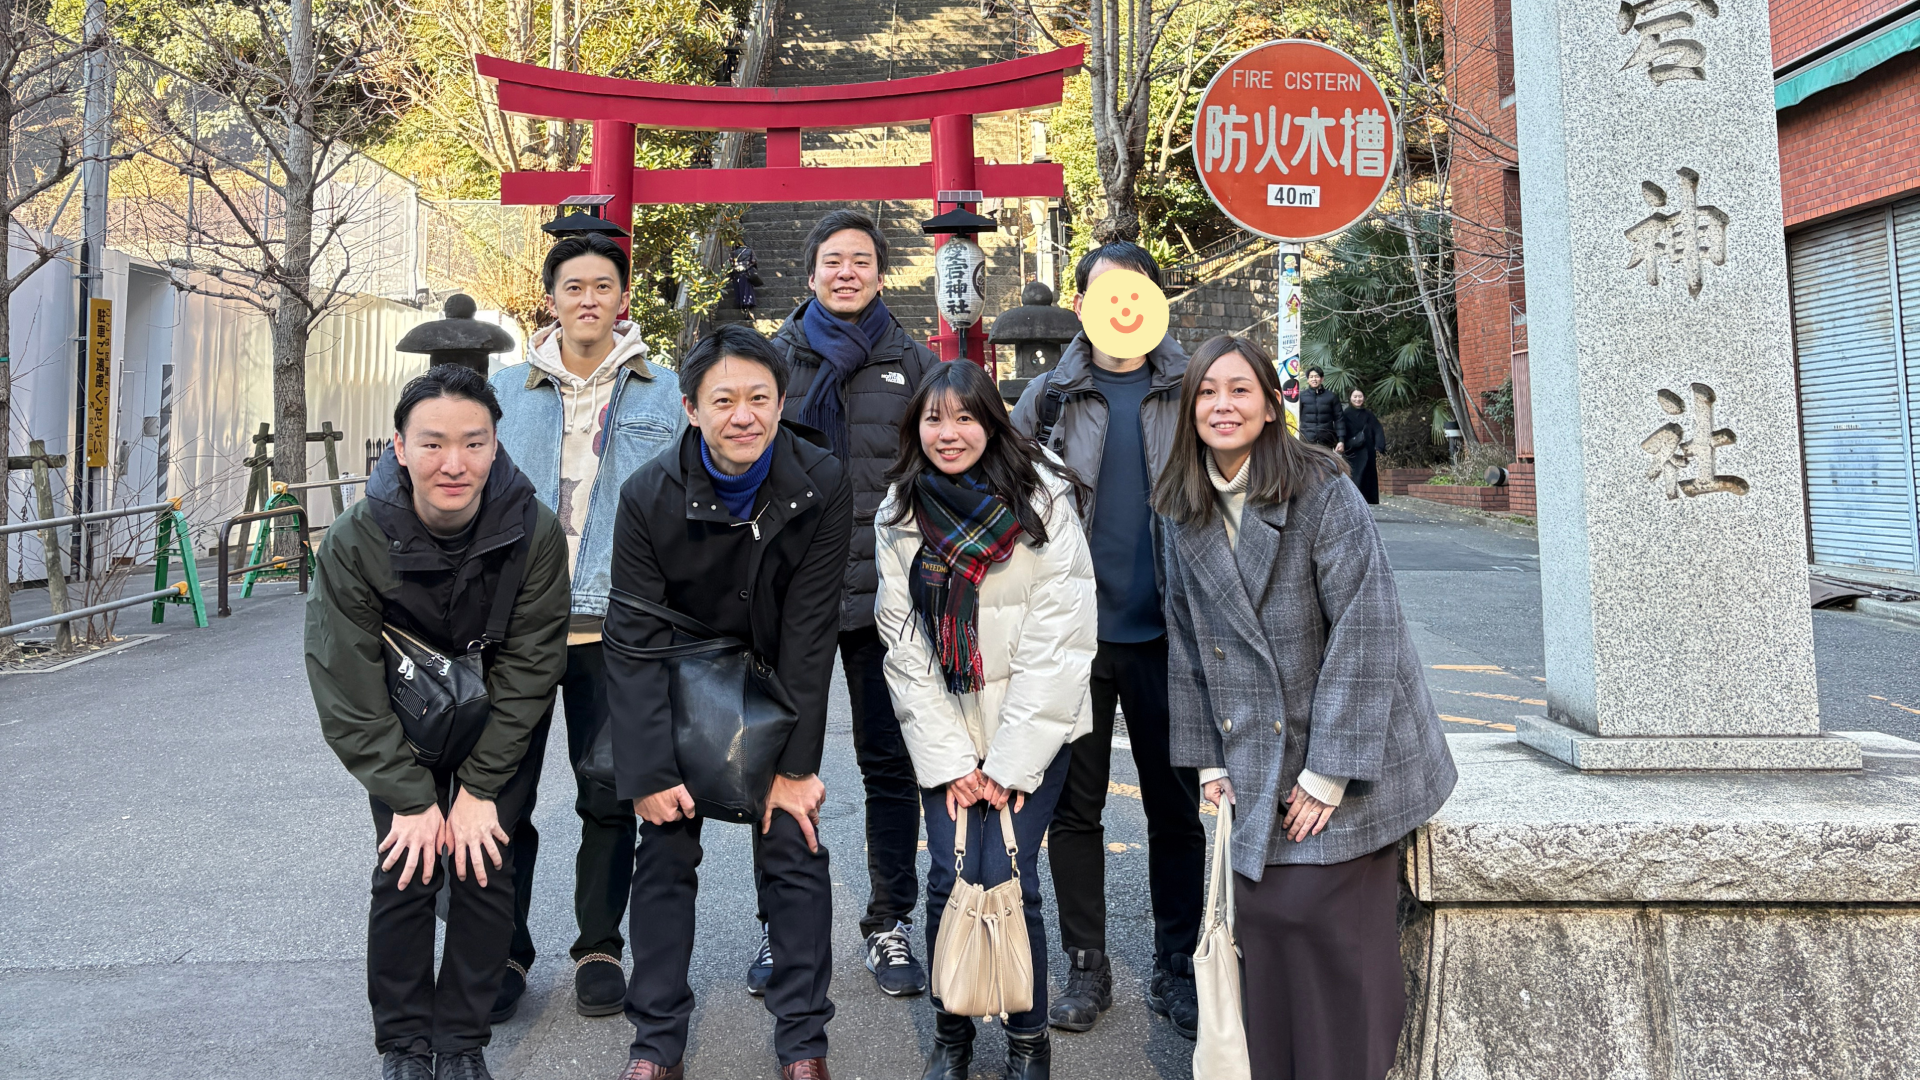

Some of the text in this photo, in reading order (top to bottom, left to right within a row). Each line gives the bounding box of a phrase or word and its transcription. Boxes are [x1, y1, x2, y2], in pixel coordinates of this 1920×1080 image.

[1232, 70, 1361, 92] FIRE CISTERN
[1205, 104, 1386, 177] 防火水槽
[944, 242, 971, 315] 愛宕神社
